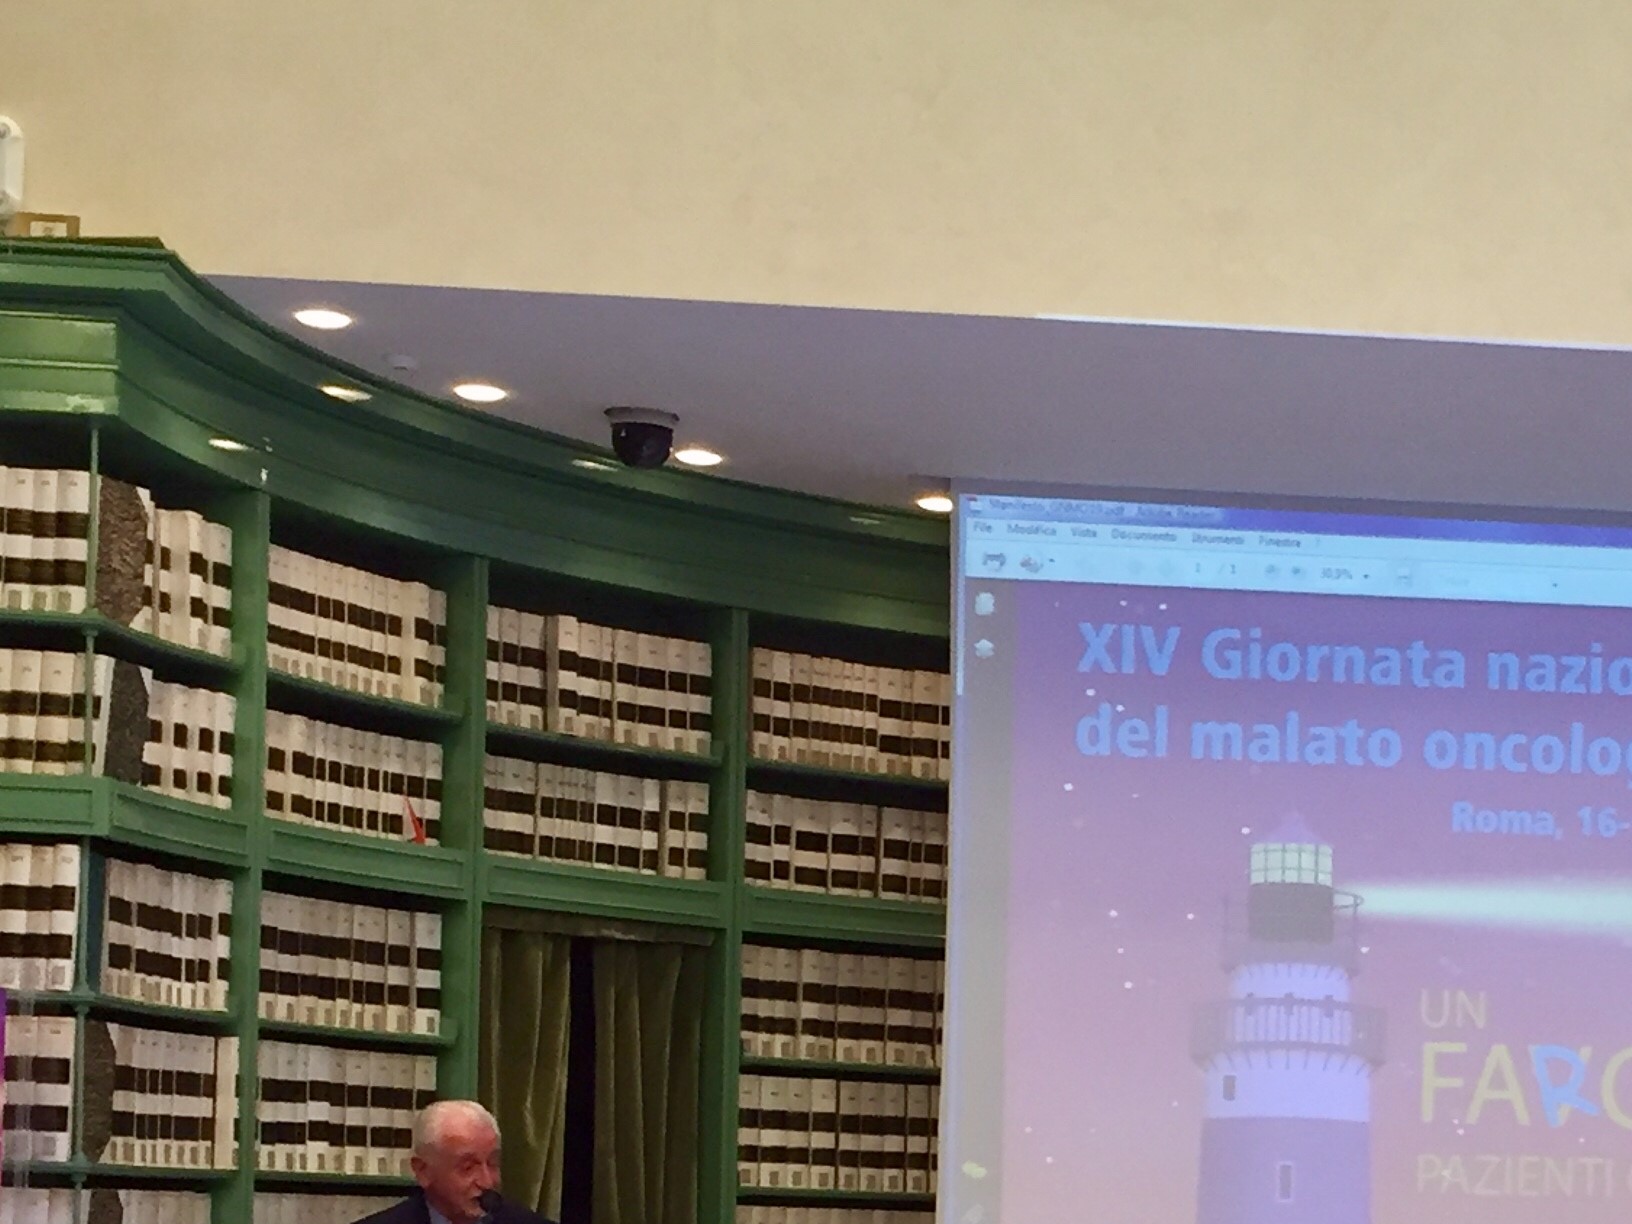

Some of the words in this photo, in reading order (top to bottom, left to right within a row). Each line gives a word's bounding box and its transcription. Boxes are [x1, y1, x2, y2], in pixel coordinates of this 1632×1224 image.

[1076, 622, 1181, 676] XIV
[1202, 627, 1466, 688] Giornata
[1075, 701, 1169, 757] del
[1190, 710, 1402, 768] malato
[1451, 801, 1564, 841] Roma,
[1420, 988, 1487, 1030] UN
[1416, 1153, 1615, 1198] PAZIENTI
